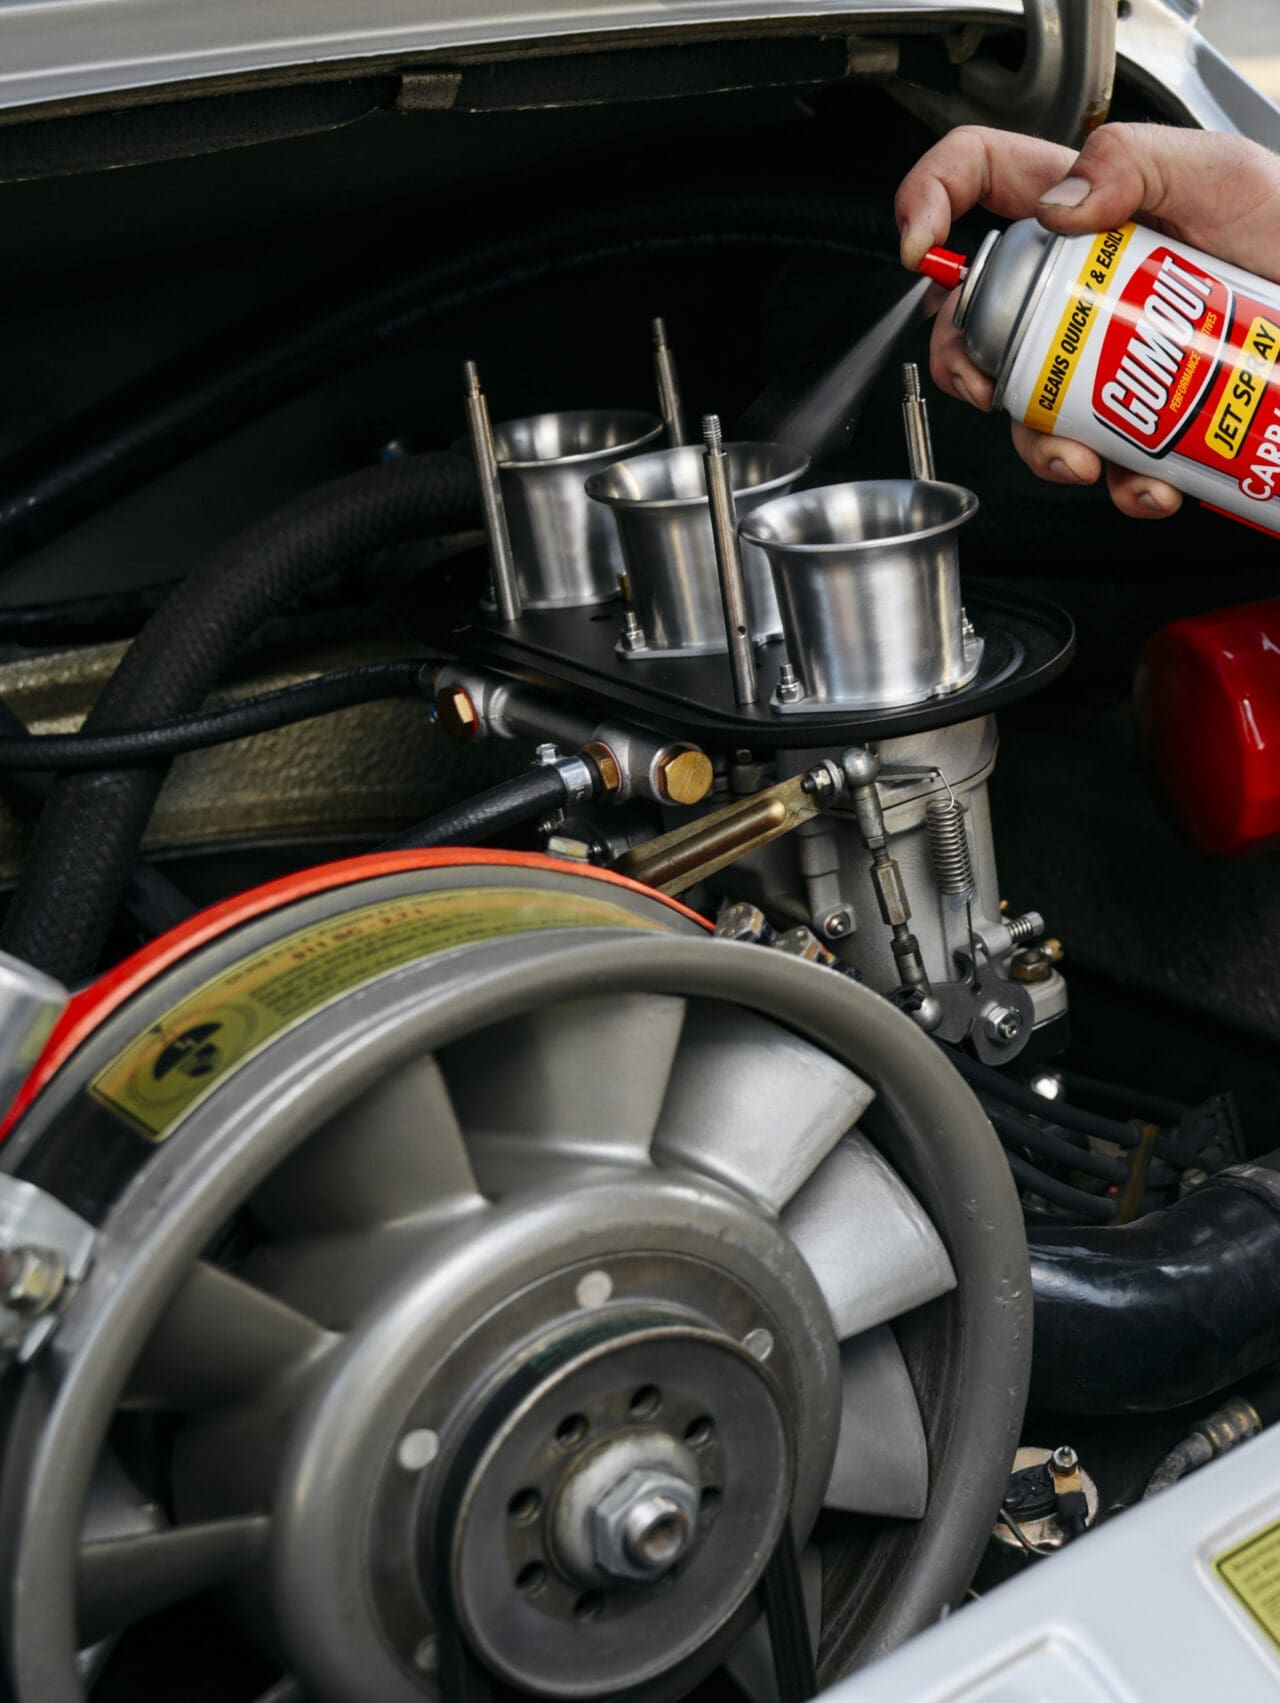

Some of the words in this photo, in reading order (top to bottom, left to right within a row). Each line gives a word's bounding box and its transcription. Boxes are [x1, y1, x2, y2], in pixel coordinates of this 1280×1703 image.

[1037, 354, 1071, 411] CLEANS
[1087, 267, 1106, 285] &
[1098, 254, 1212, 438] GUMOUT
[1168, 351, 1202, 413] PERFORMANCE
[1213, 402, 1243, 451] JET
[1231, 323, 1276, 407] SPRAY
